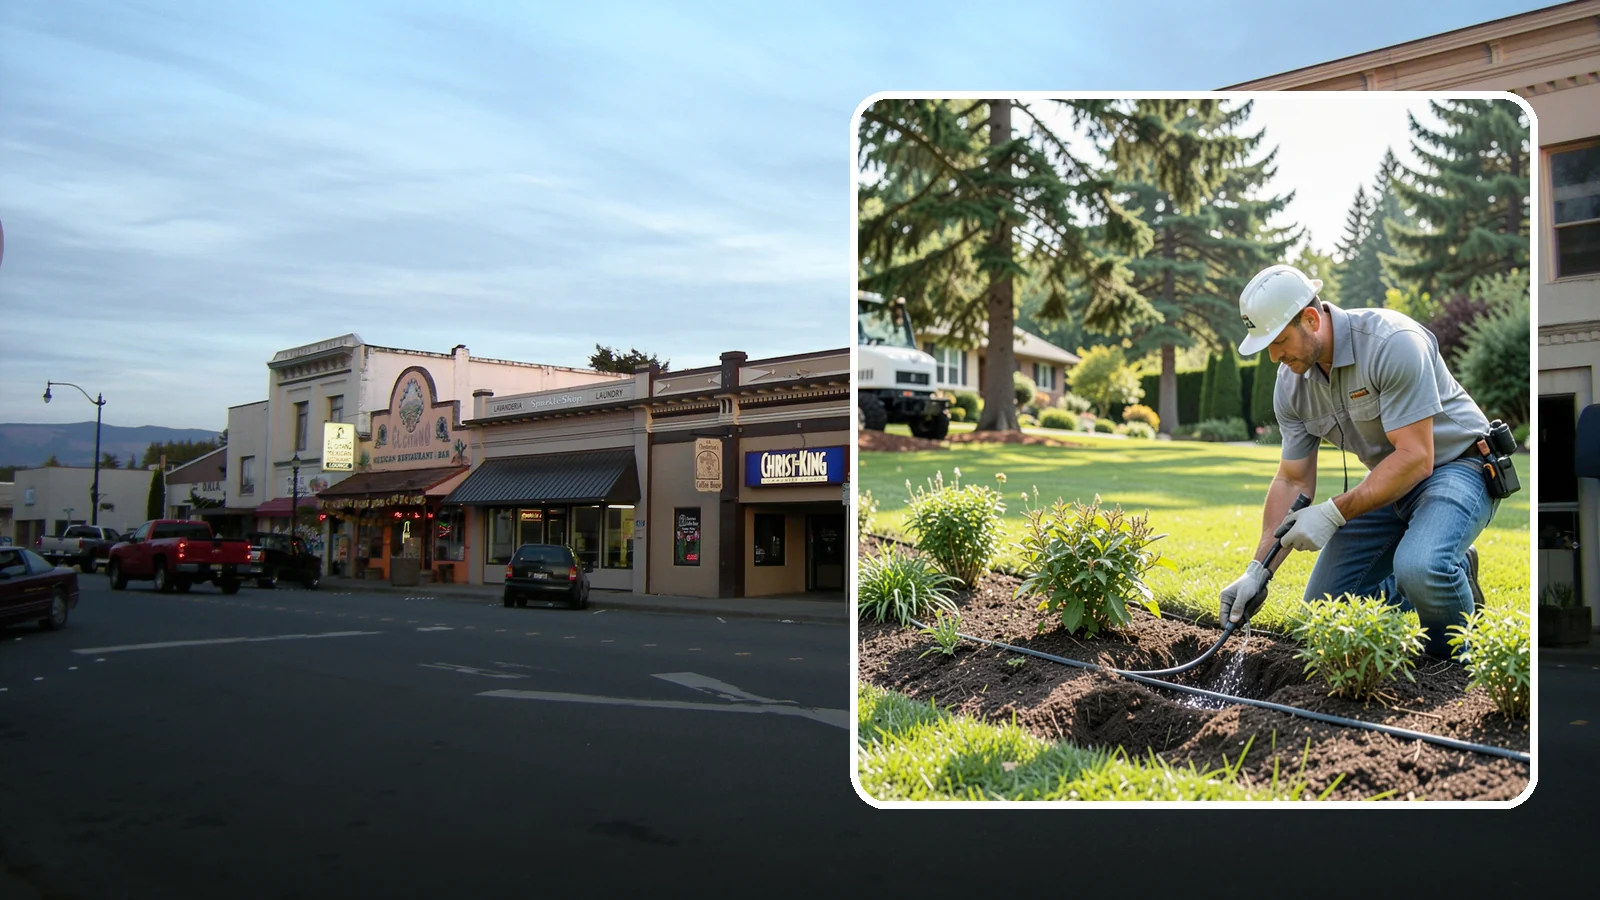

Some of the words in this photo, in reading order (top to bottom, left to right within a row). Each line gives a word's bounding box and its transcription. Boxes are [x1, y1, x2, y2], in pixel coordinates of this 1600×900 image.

[595, 388, 623, 400] LAUNDRY
[493, 402, 523, 413] LAVANDERIA
[530, 397, 562, 410] Sparkle
[562, 394, 582, 406] Shop
[397, 451, 433, 463] RESTAURANT
[438, 450, 450, 459] BAR
[761, 451, 797, 479] CHRIST
[799, 449, 828, 477] KING
